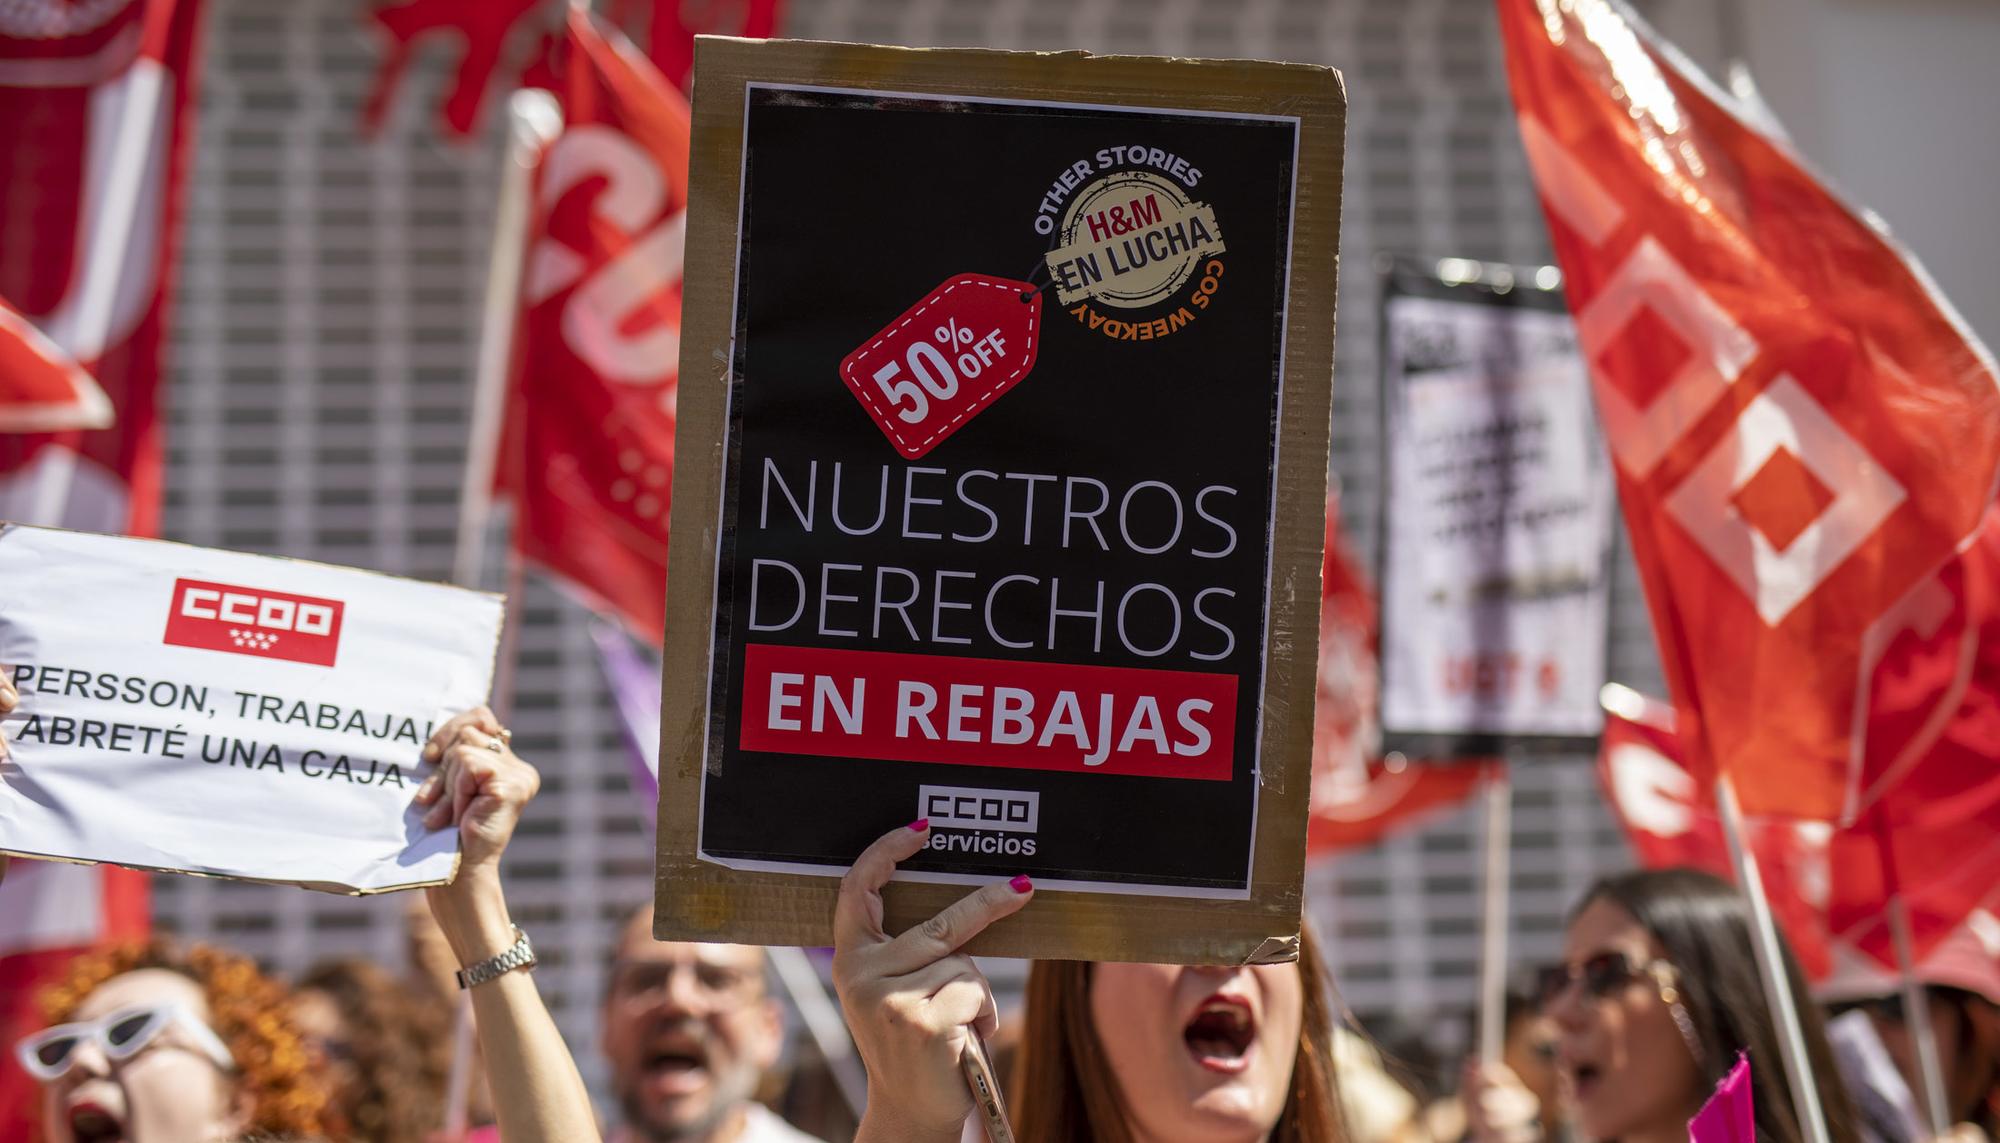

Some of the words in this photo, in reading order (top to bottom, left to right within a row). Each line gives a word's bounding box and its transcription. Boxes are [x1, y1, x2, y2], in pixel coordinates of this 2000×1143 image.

[1034, 159, 1095, 235] OTHER
[1095, 145, 1203, 187] STORIES
[1086, 194, 1162, 243] H&M
[1057, 252, 1103, 292] EN
[1105, 215, 1213, 276] LUCHA
[1191, 259, 1225, 309] COS
[1069, 303, 1196, 341] WEEKDAY
[957, 328, 1007, 379] OFF
[759, 457, 1239, 559] NUESTROS
[181, 587, 333, 636] CCOO
[748, 558, 1237, 661] DERECHOS
[12, 664, 216, 718] PERSSON,
[767, 671, 866, 735] EN
[895, 680, 1214, 766] REBAJAS
[16, 714, 188, 759] ABRETÉ
[200, 734, 285, 773] UNA
[300, 750, 405, 789] CAJA
[927, 794, 1030, 823] CCOO
